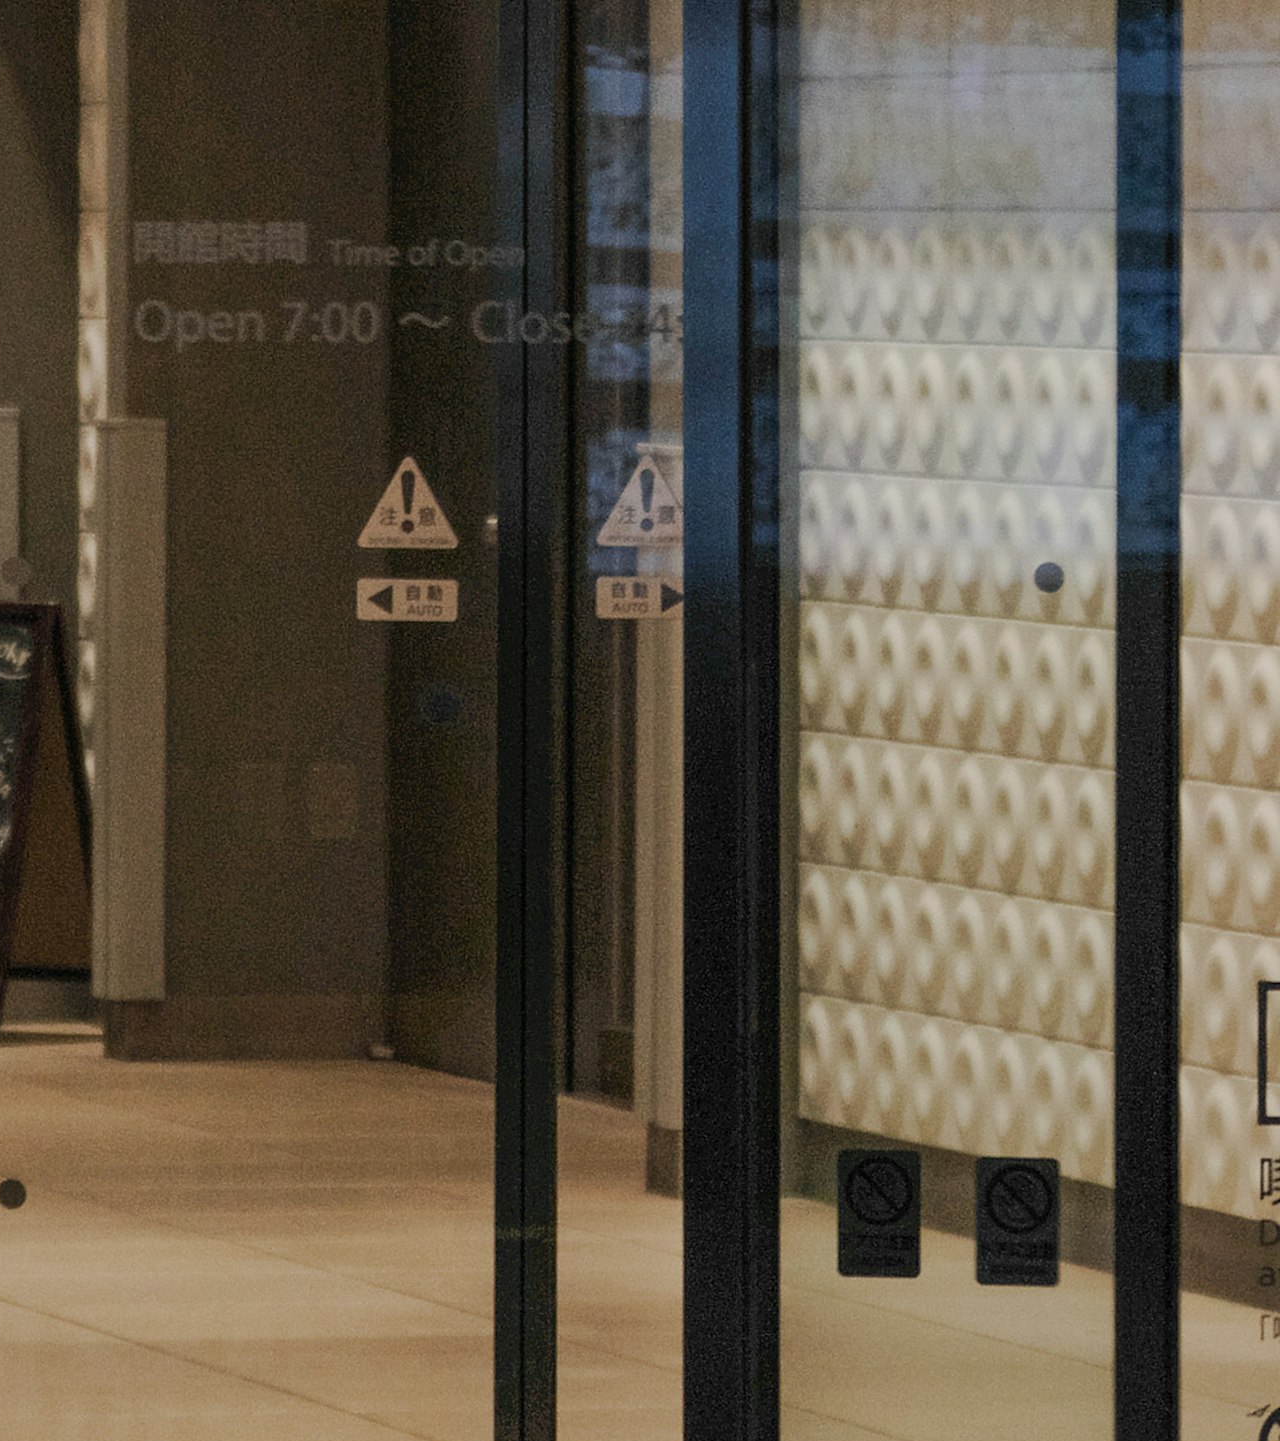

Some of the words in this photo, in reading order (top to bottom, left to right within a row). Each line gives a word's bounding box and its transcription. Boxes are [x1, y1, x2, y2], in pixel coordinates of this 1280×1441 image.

[329, 239, 400, 267] Time
[407, 239, 440, 267] of
[443, 239, 525, 272] Open
[134, 298, 266, 352] Open
[279, 298, 381, 345] 7:00
[469, 297, 598, 346] Close
[406, 585, 444, 602] 自動
[406, 604, 444, 618] AUTO
[612, 602, 649, 615] AUTO
